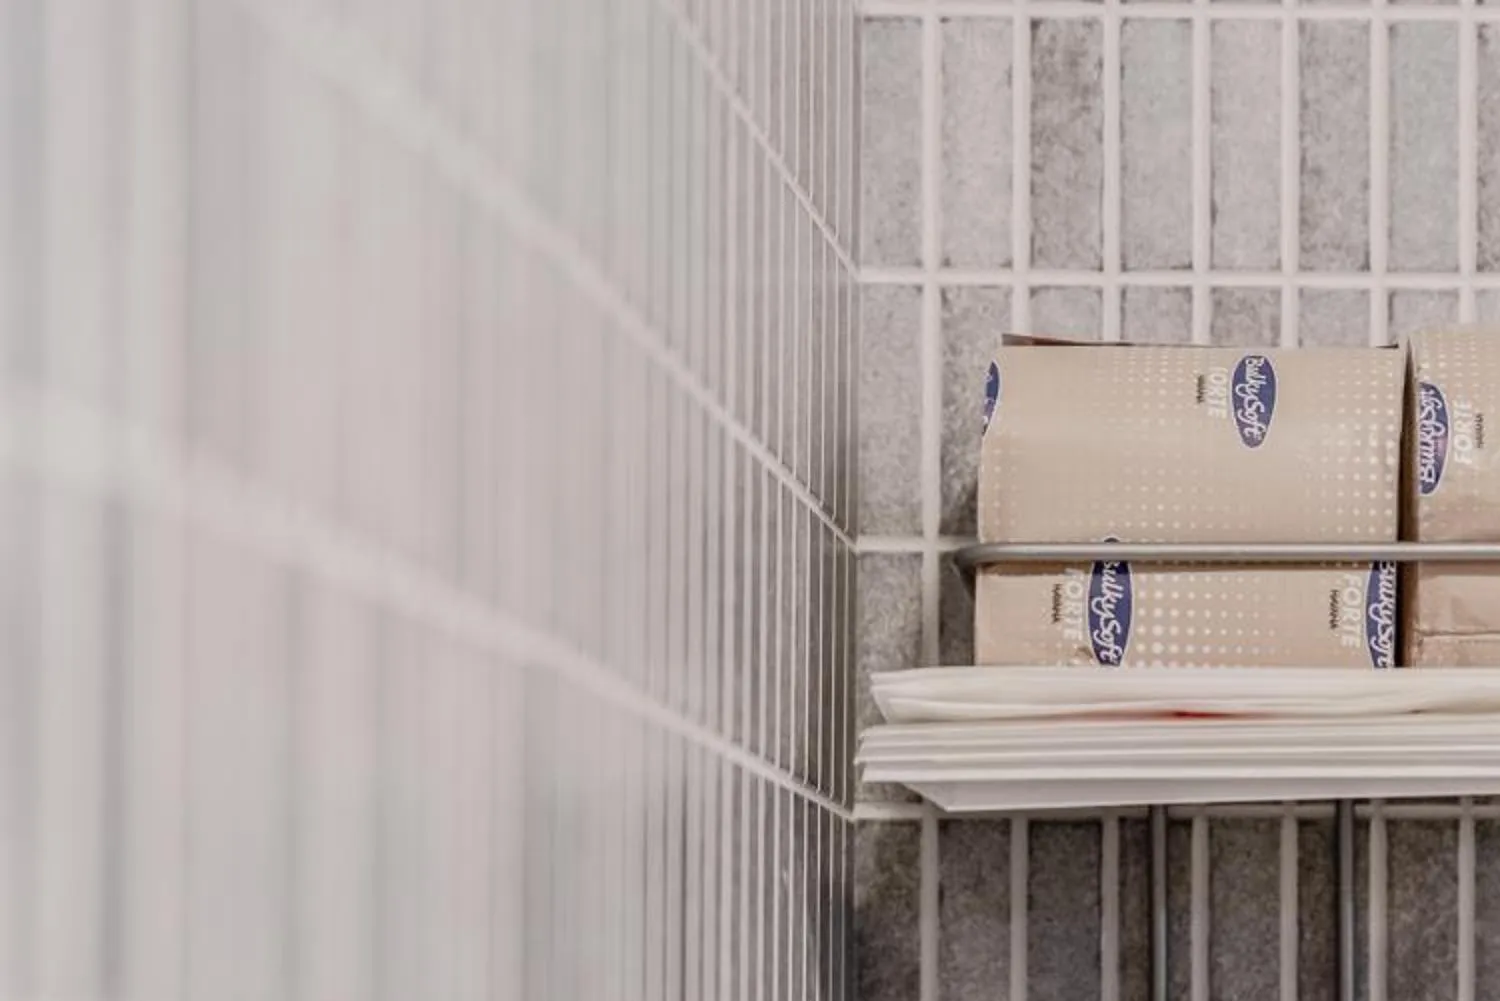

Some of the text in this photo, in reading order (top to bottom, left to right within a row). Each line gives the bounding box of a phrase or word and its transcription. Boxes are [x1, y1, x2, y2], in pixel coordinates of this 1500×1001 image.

[1235, 356, 1267, 438] BulkySoft
[1452, 399, 1473, 466] FORTE
[1341, 573, 1362, 649] FORTE
